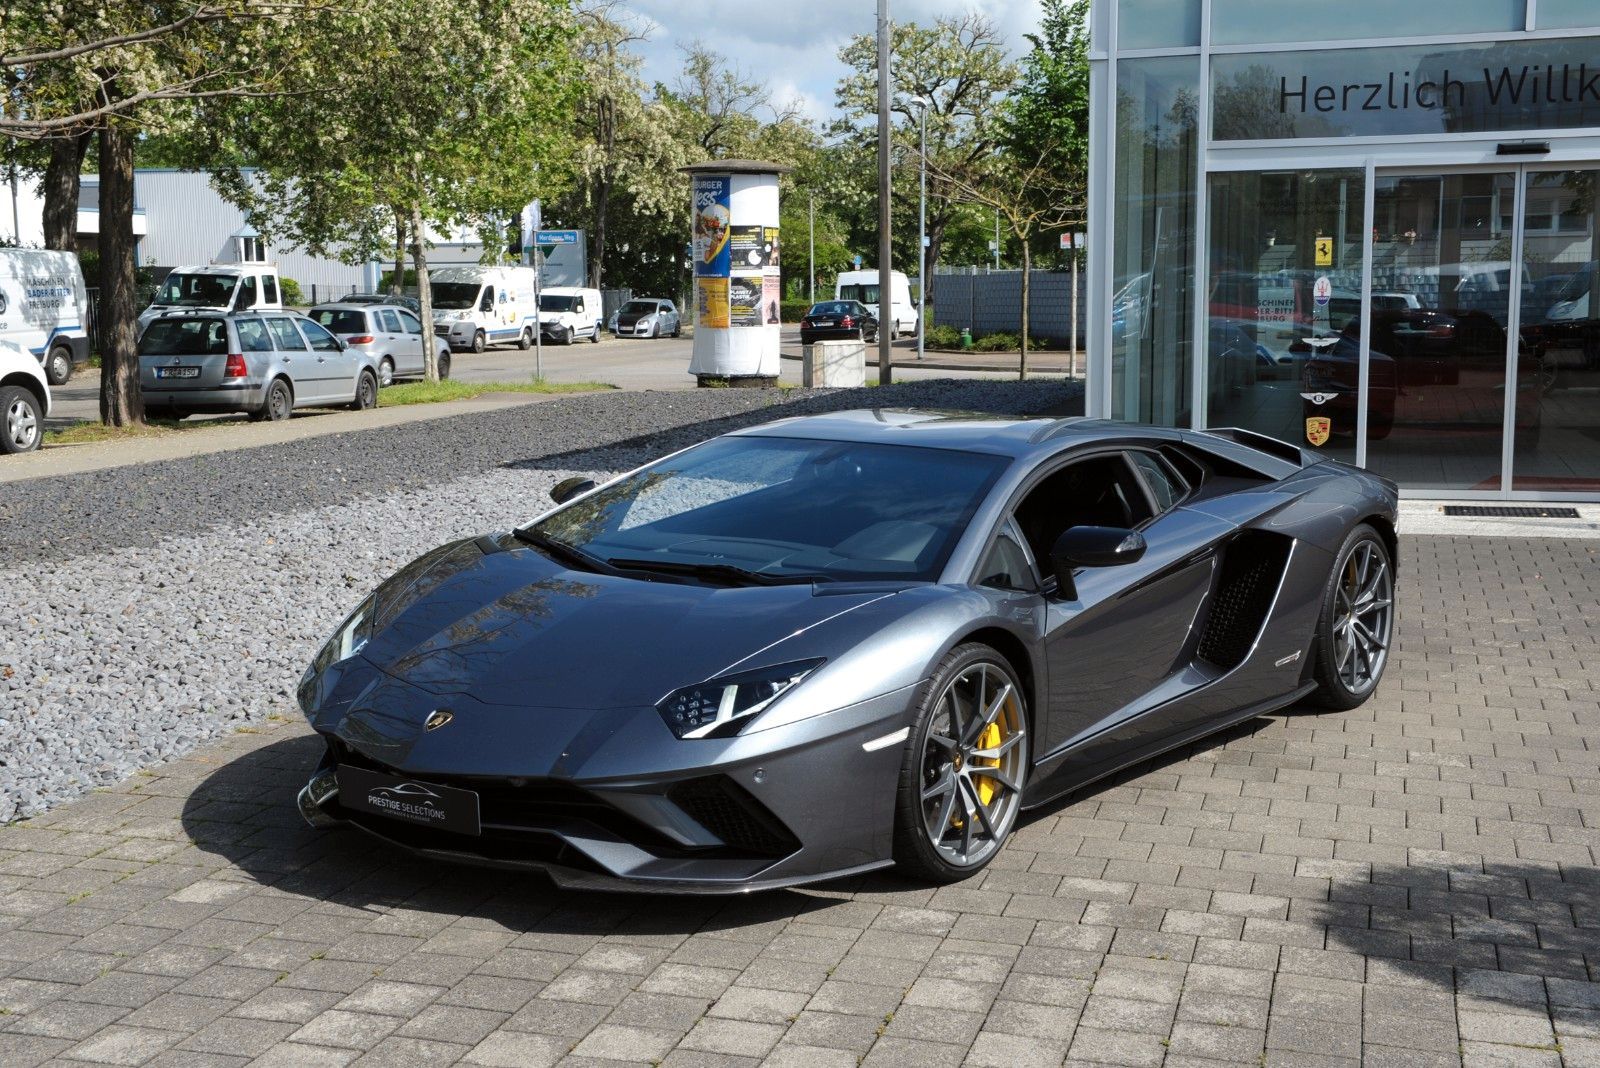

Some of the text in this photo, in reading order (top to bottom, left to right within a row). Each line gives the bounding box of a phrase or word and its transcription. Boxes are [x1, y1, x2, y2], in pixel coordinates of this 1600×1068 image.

[1280, 63, 1600, 113] Herzlich Willk
[29, 300, 60, 309] FREIBURG
[368, 795, 401, 811] PRESTIGE
[401, 803, 446, 820] SELECTIONS
